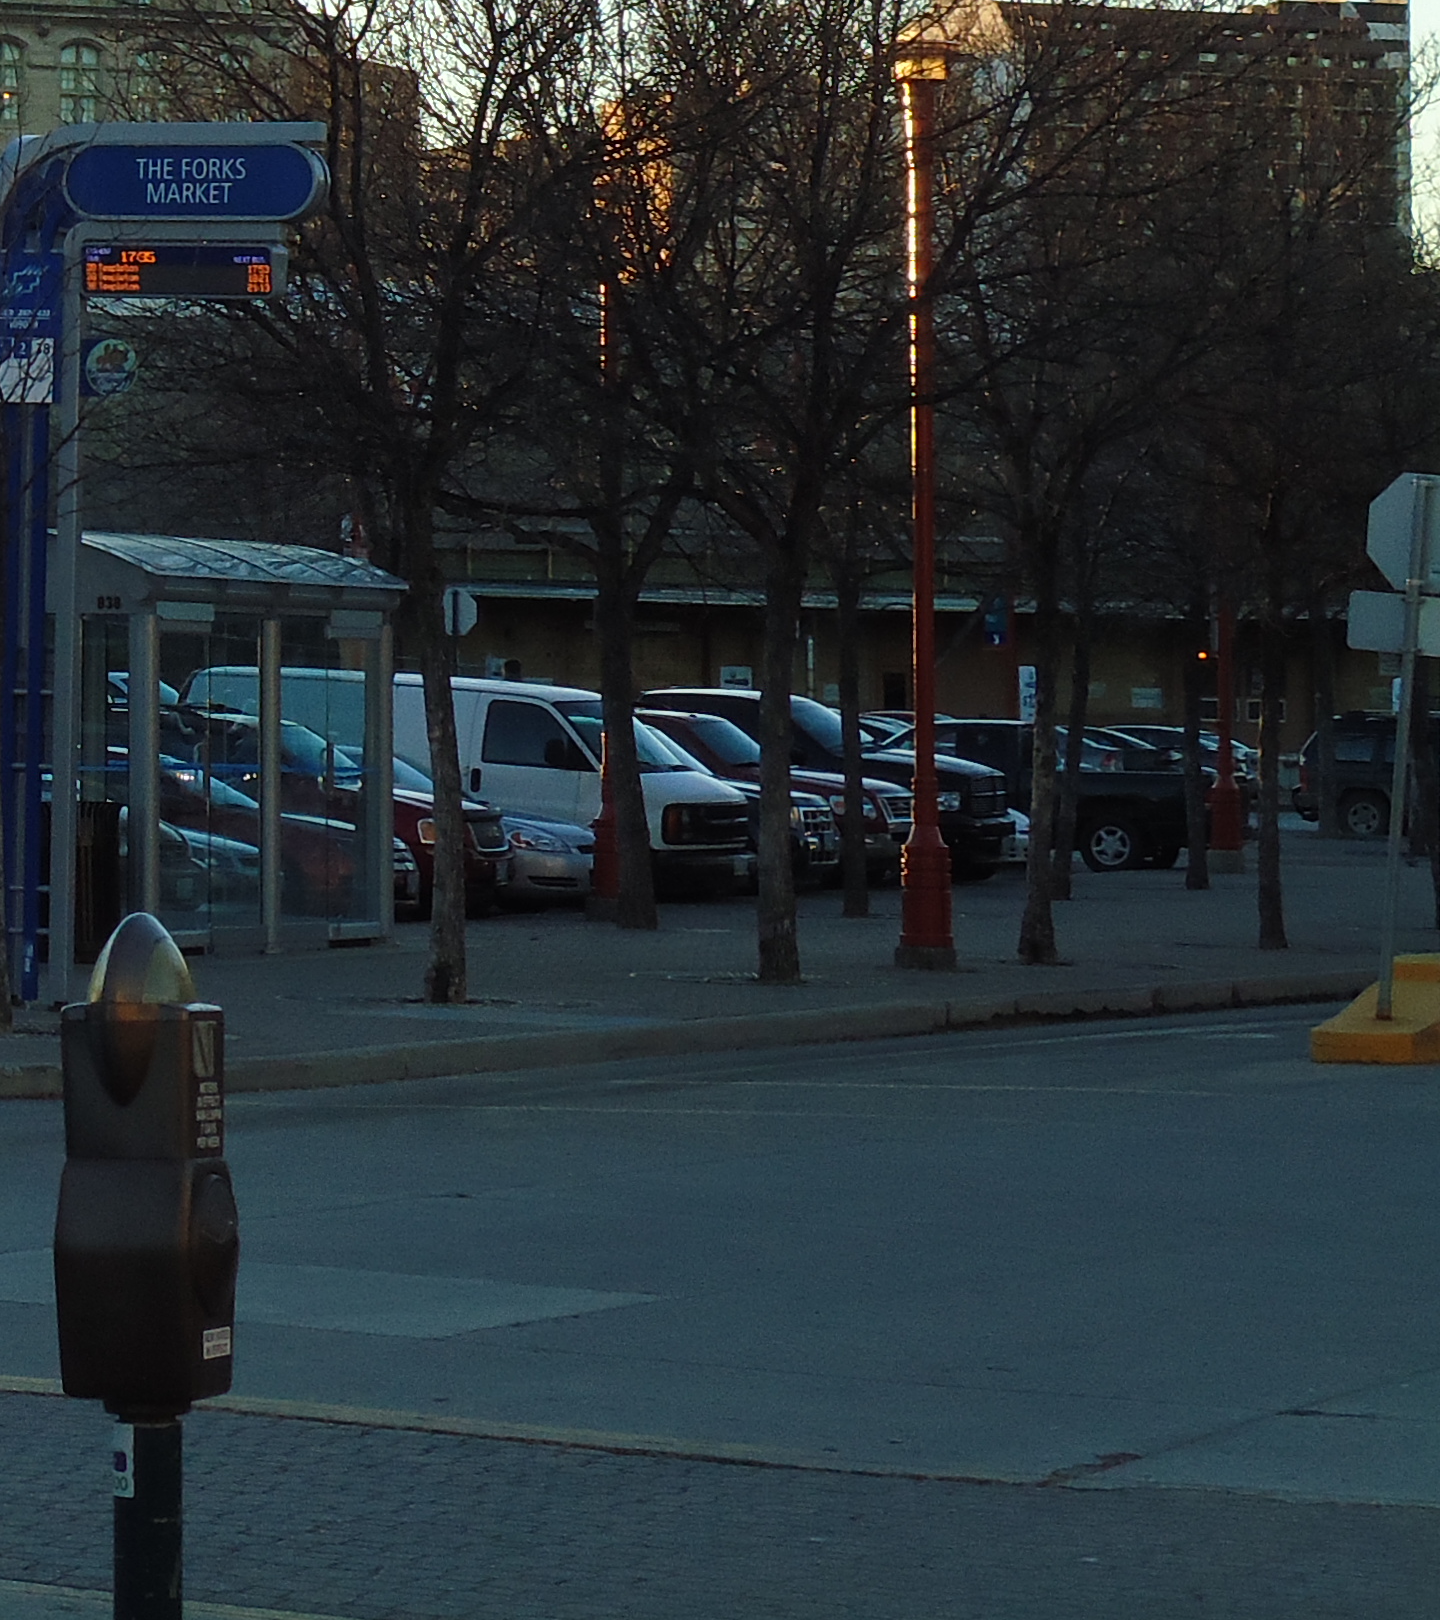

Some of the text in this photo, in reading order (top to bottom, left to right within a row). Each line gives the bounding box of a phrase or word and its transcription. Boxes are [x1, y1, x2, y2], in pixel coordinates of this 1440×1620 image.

[136, 157, 246, 179] THE FORKS
[146, 182, 233, 205] MARKET
